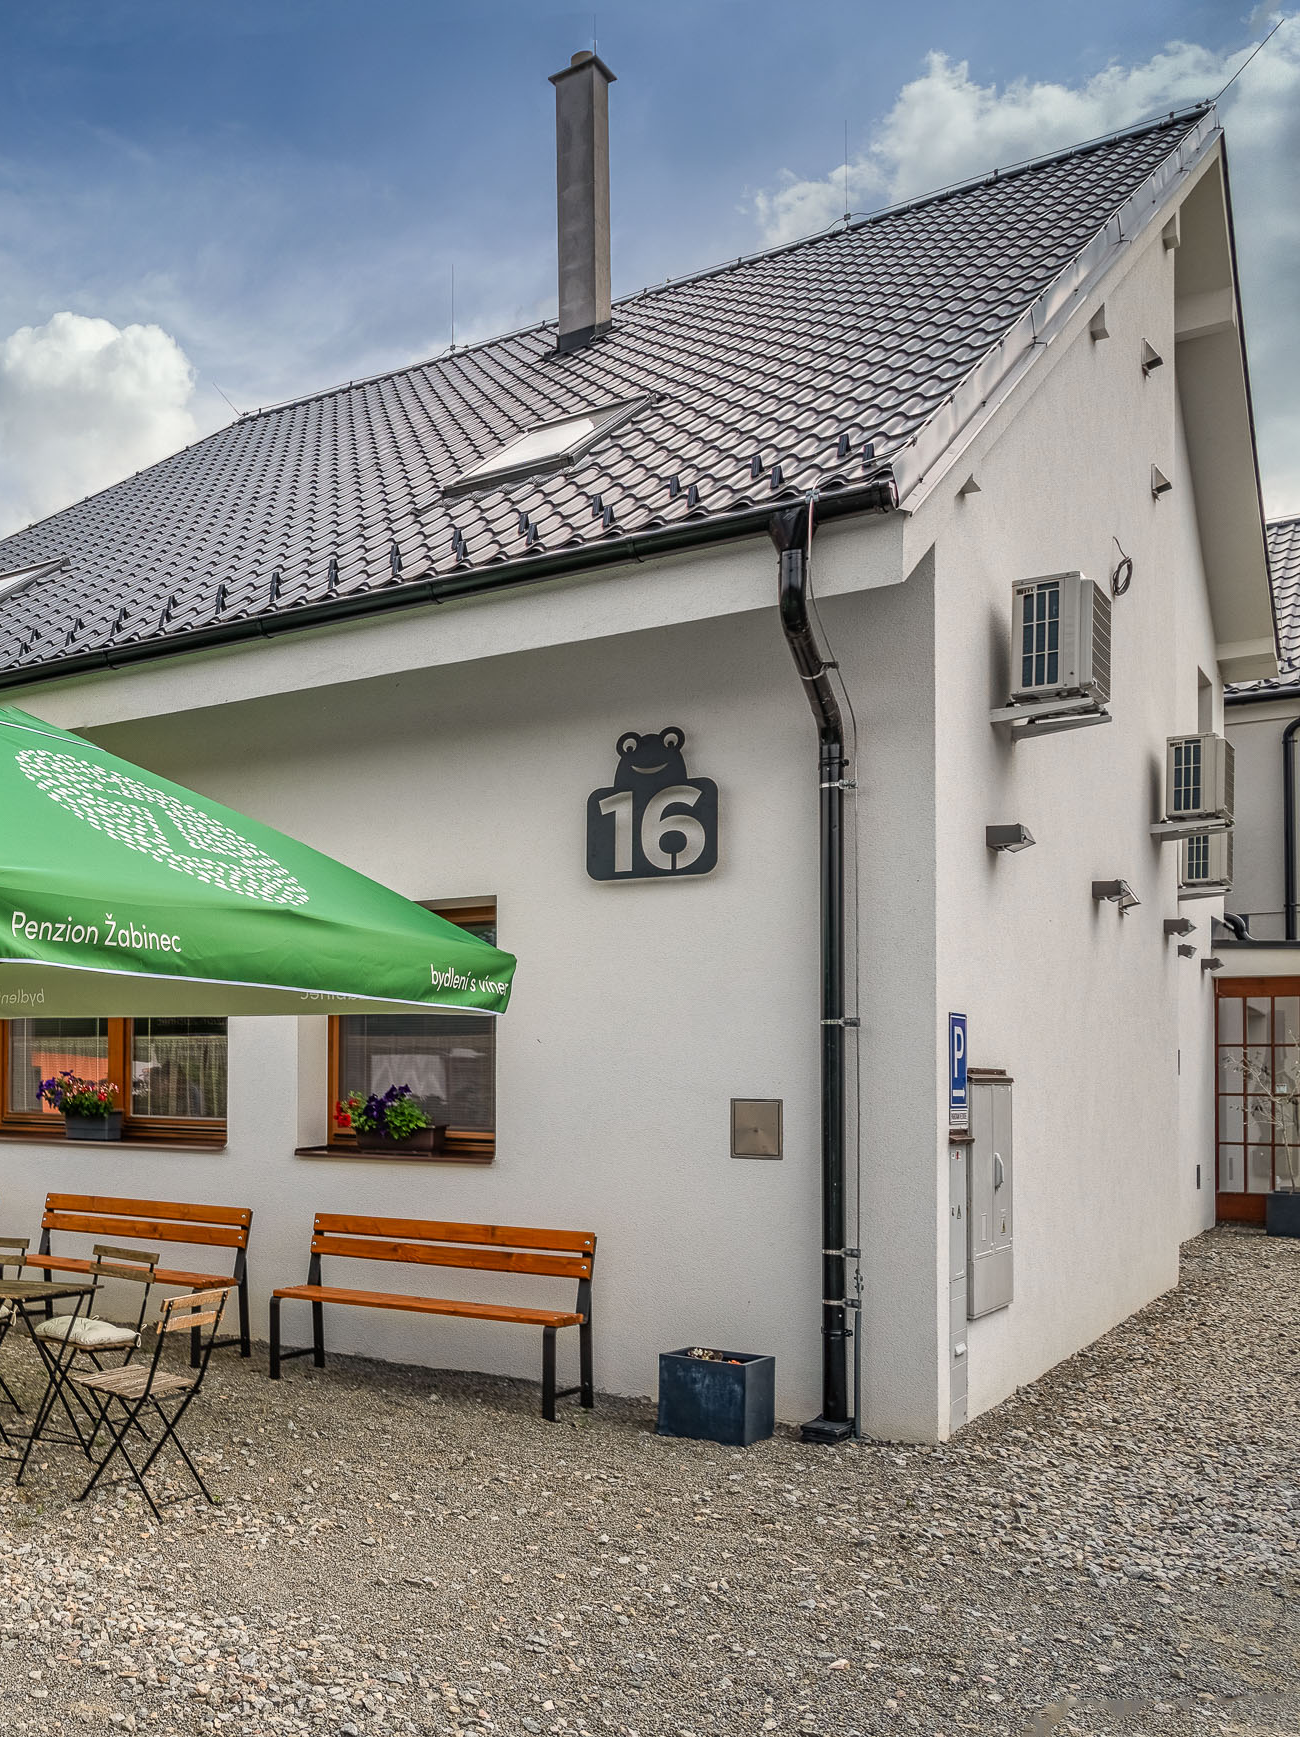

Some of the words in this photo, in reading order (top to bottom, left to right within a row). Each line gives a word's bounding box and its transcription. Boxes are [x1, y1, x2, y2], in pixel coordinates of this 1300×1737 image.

[598, 784, 706, 873] 16
[12, 910, 99, 945] Penzion
[104, 912, 182, 953] Žabinec
[430, 963, 471, 992] bydlení
[470, 978, 477, 992] s
[954, 1026, 964, 1078] P
